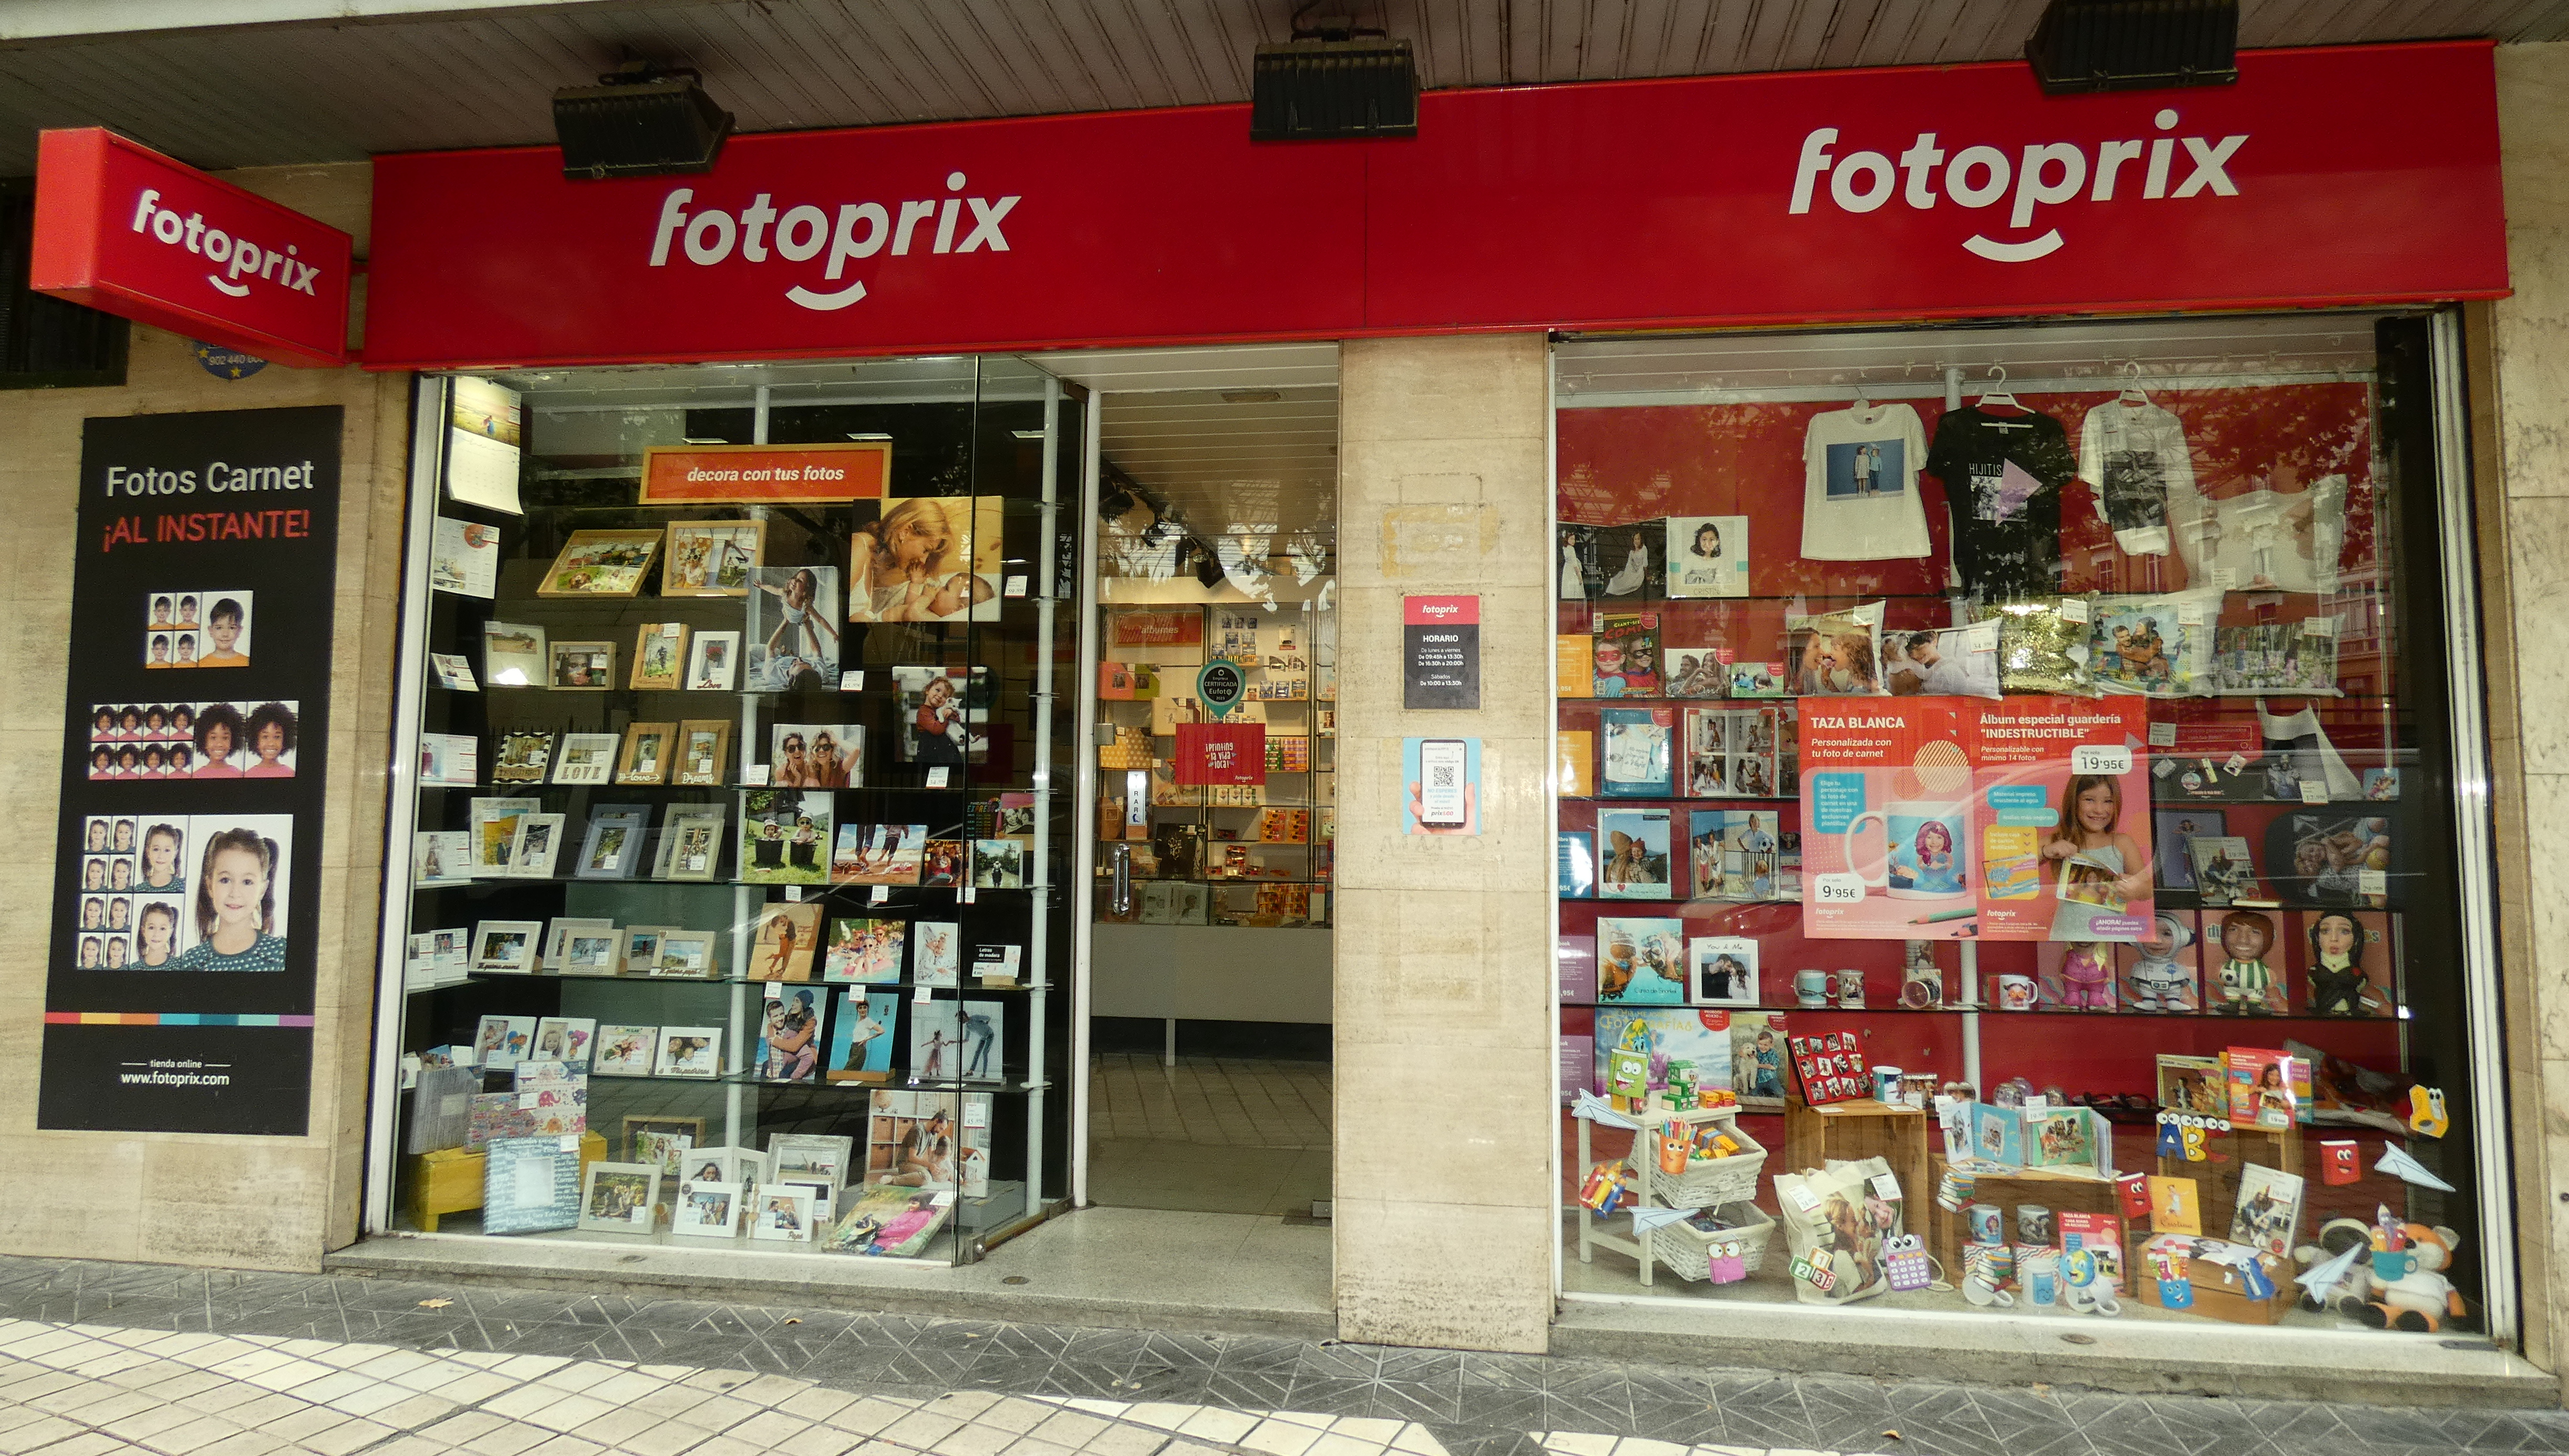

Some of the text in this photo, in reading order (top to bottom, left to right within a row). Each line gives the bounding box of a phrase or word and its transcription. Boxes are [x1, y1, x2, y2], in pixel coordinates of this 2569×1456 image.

[1788, 109, 2250, 228] fotoprix
[649, 172, 1021, 280] fotoprix
[132, 189, 321, 296] fotoprix
[106, 460, 315, 496] Fotos Carnet
[687, 465, 844, 482] decora con tus fotos
[103, 509, 310, 552] ¡AL INSTANTE!
[1422, 605, 1458, 615] fotoprix
[697, 679, 722, 689] Love
[1810, 716, 1905, 729] TAZA BLANCA
[1980, 712, 2121, 726] Álbum especial guardería
[1981, 728, 2089, 739] "INDESTRUCTIBLE"
[1811, 737, 1873, 746] Personalizada
[1823, 749, 1841, 757] foto
[1843, 748, 1853, 757] de
[561, 766, 602, 780] LOVE
[630, 768, 650, 782] love
[682, 772, 714, 785] Dreams
[1822, 885, 1856, 898] 9'95€
[1816, 908, 1844, 916] fotoprix
[1987, 909, 2016, 918] fotoprix
[150, 1058, 202, 1068] tienda online
[121, 1071, 230, 1087] www.fotoprix.com
[2156, 1122, 2230, 1163] ABC
[1820, 1255, 1825, 1265] 1
[1798, 1266, 1807, 1276] 2
[1816, 1273, 1823, 1283] 3
